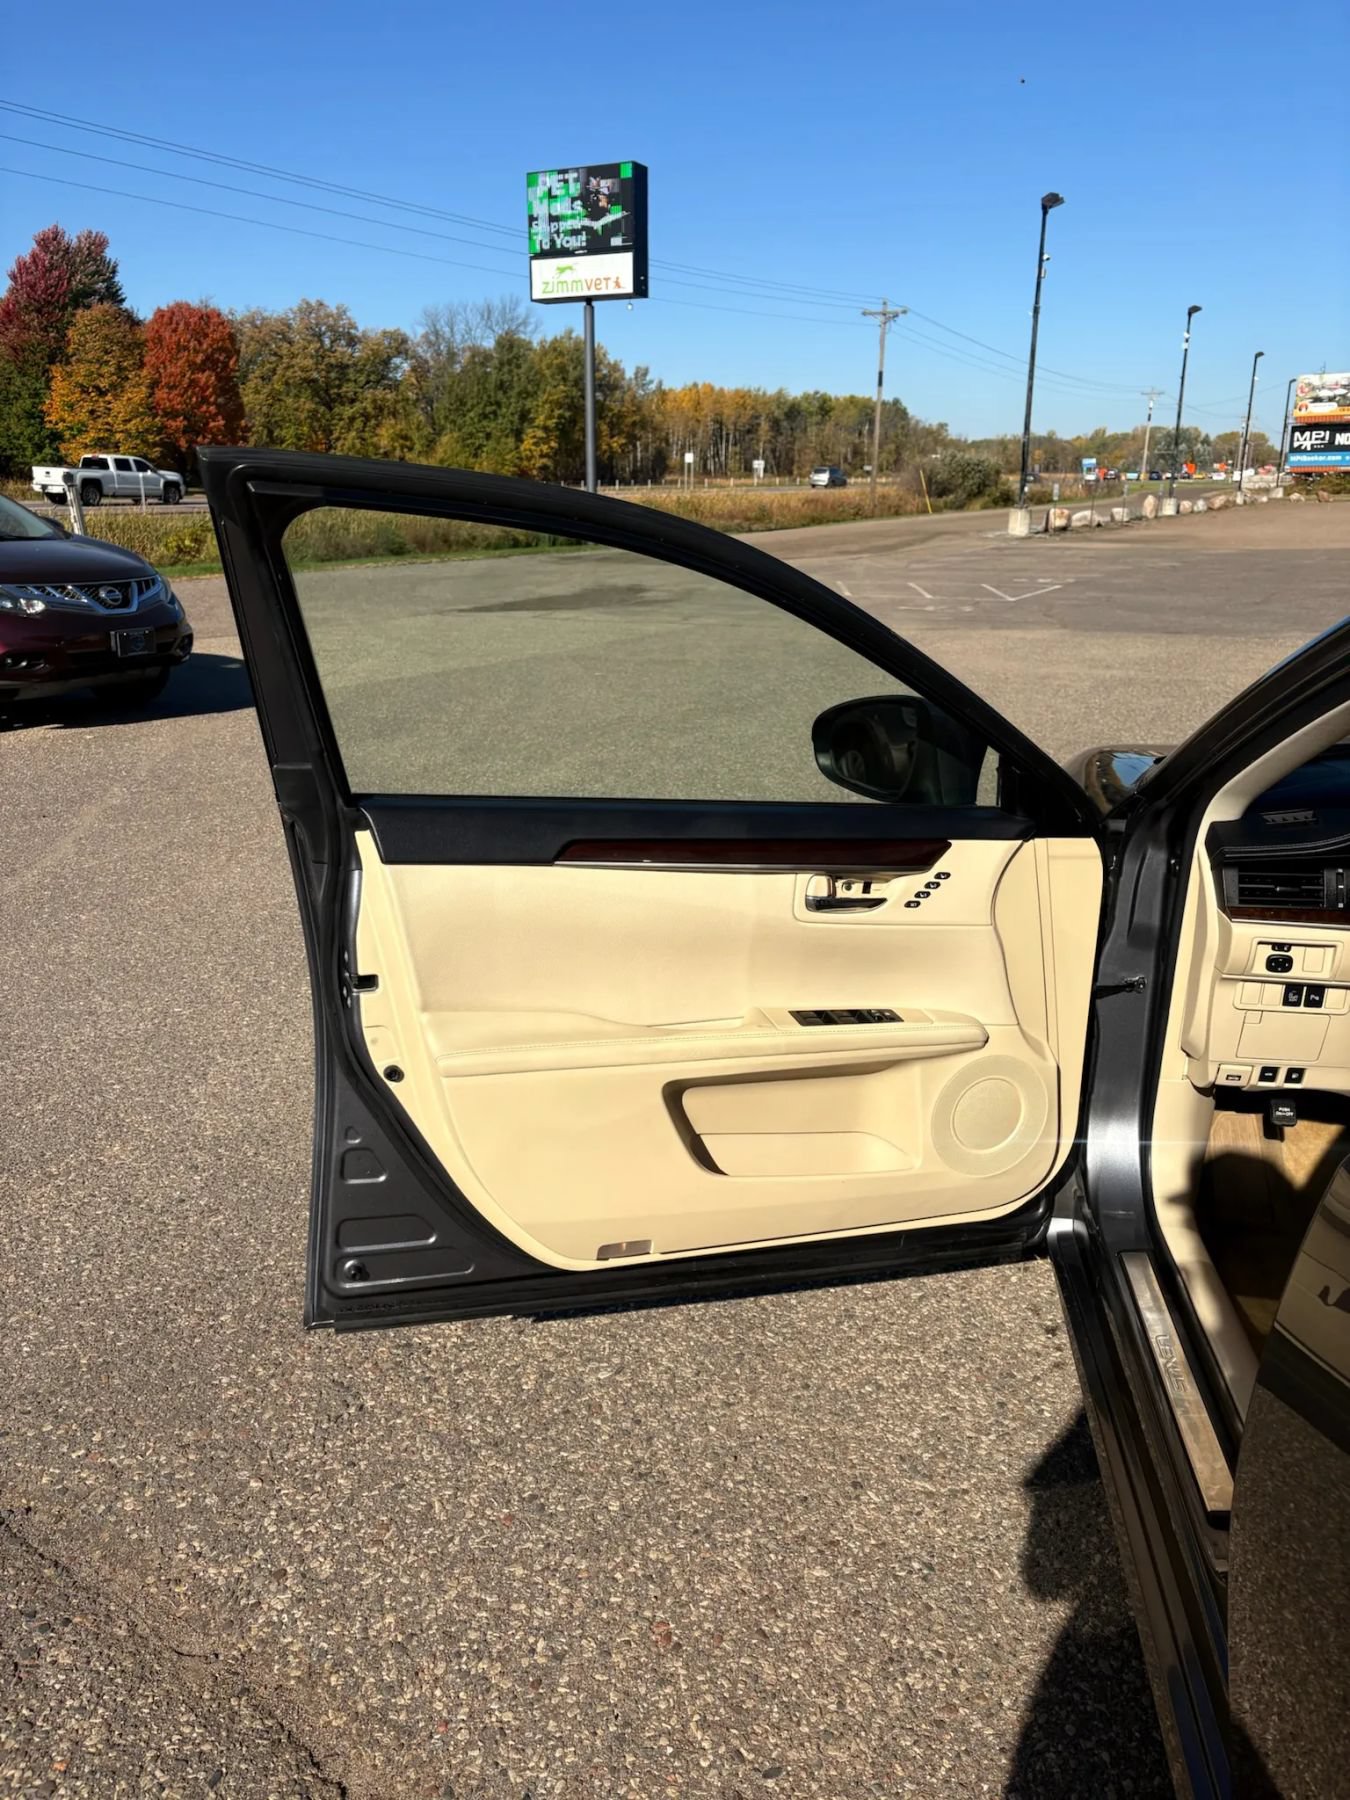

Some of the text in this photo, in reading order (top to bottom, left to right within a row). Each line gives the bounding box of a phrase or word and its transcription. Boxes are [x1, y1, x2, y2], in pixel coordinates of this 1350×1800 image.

[532, 216, 582, 233] Spped
[551, 231, 587, 249] You!
[1294, 430, 1330, 442] MPI
[1154, 1334, 1188, 1393] LEXUS
